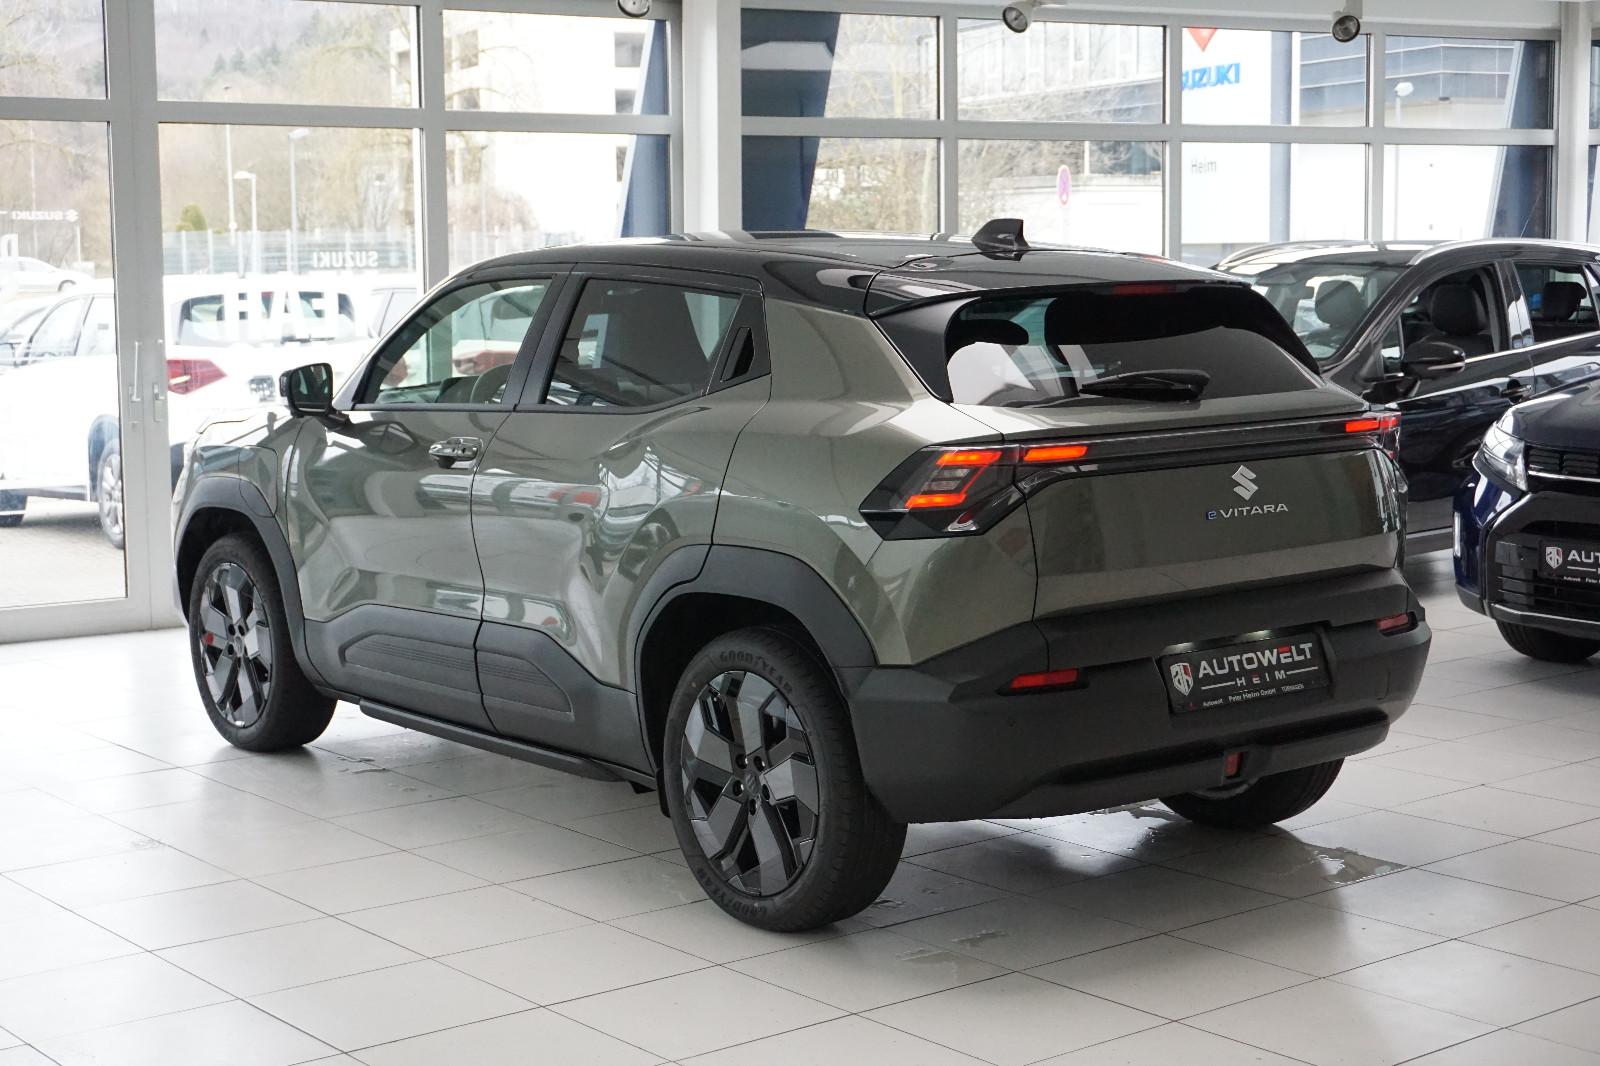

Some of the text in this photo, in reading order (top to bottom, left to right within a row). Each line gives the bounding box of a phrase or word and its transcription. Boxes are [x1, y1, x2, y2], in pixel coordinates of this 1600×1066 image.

[1191, 158, 1217, 174] Heim
[719, 651, 793, 694] GOODYEAR
[1198, 642, 1313, 679] AUTOWELT
